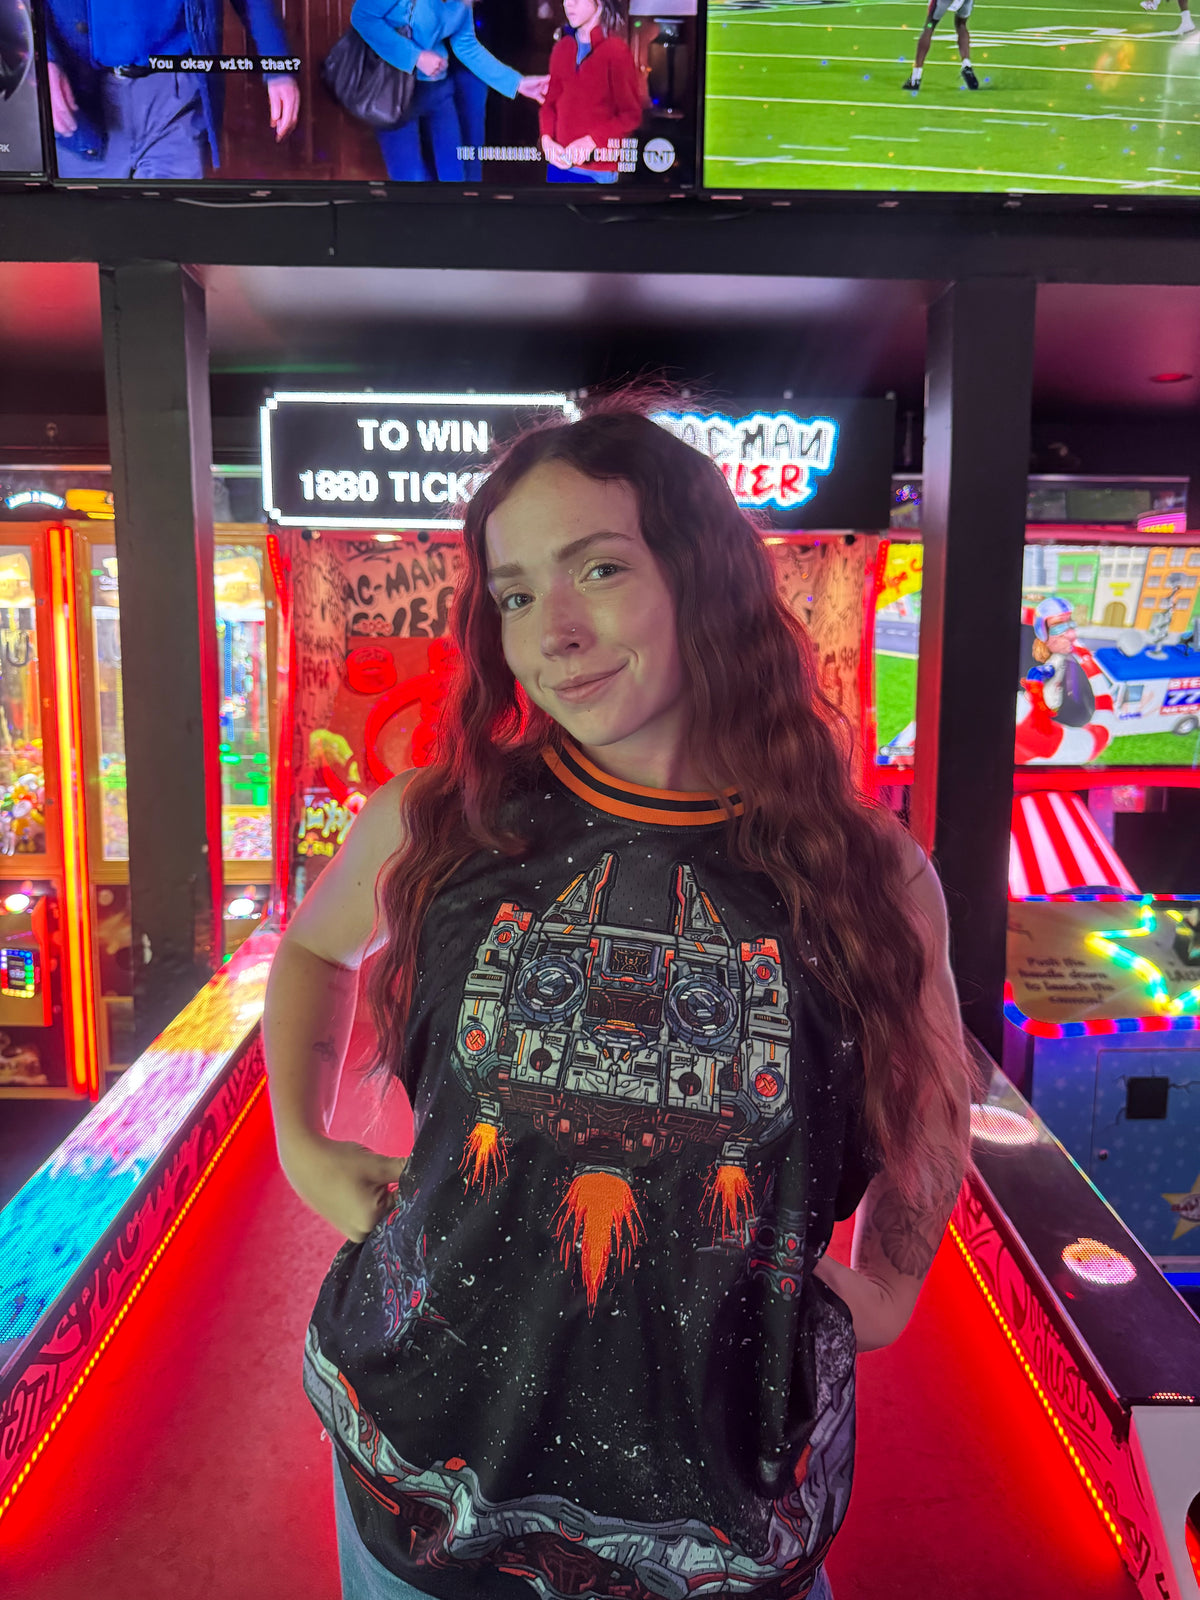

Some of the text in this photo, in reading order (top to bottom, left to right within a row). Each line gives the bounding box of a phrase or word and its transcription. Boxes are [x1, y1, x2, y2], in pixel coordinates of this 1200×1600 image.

[149, 58, 301, 72] You okay with that?
[457, 146, 475, 160] THE
[478, 146, 541, 161] LIBRARIANS:
[594, 148, 638, 161] CHAPTER
[357, 419, 488, 452] TO WIN
[299, 469, 492, 503] 1880 TICK
